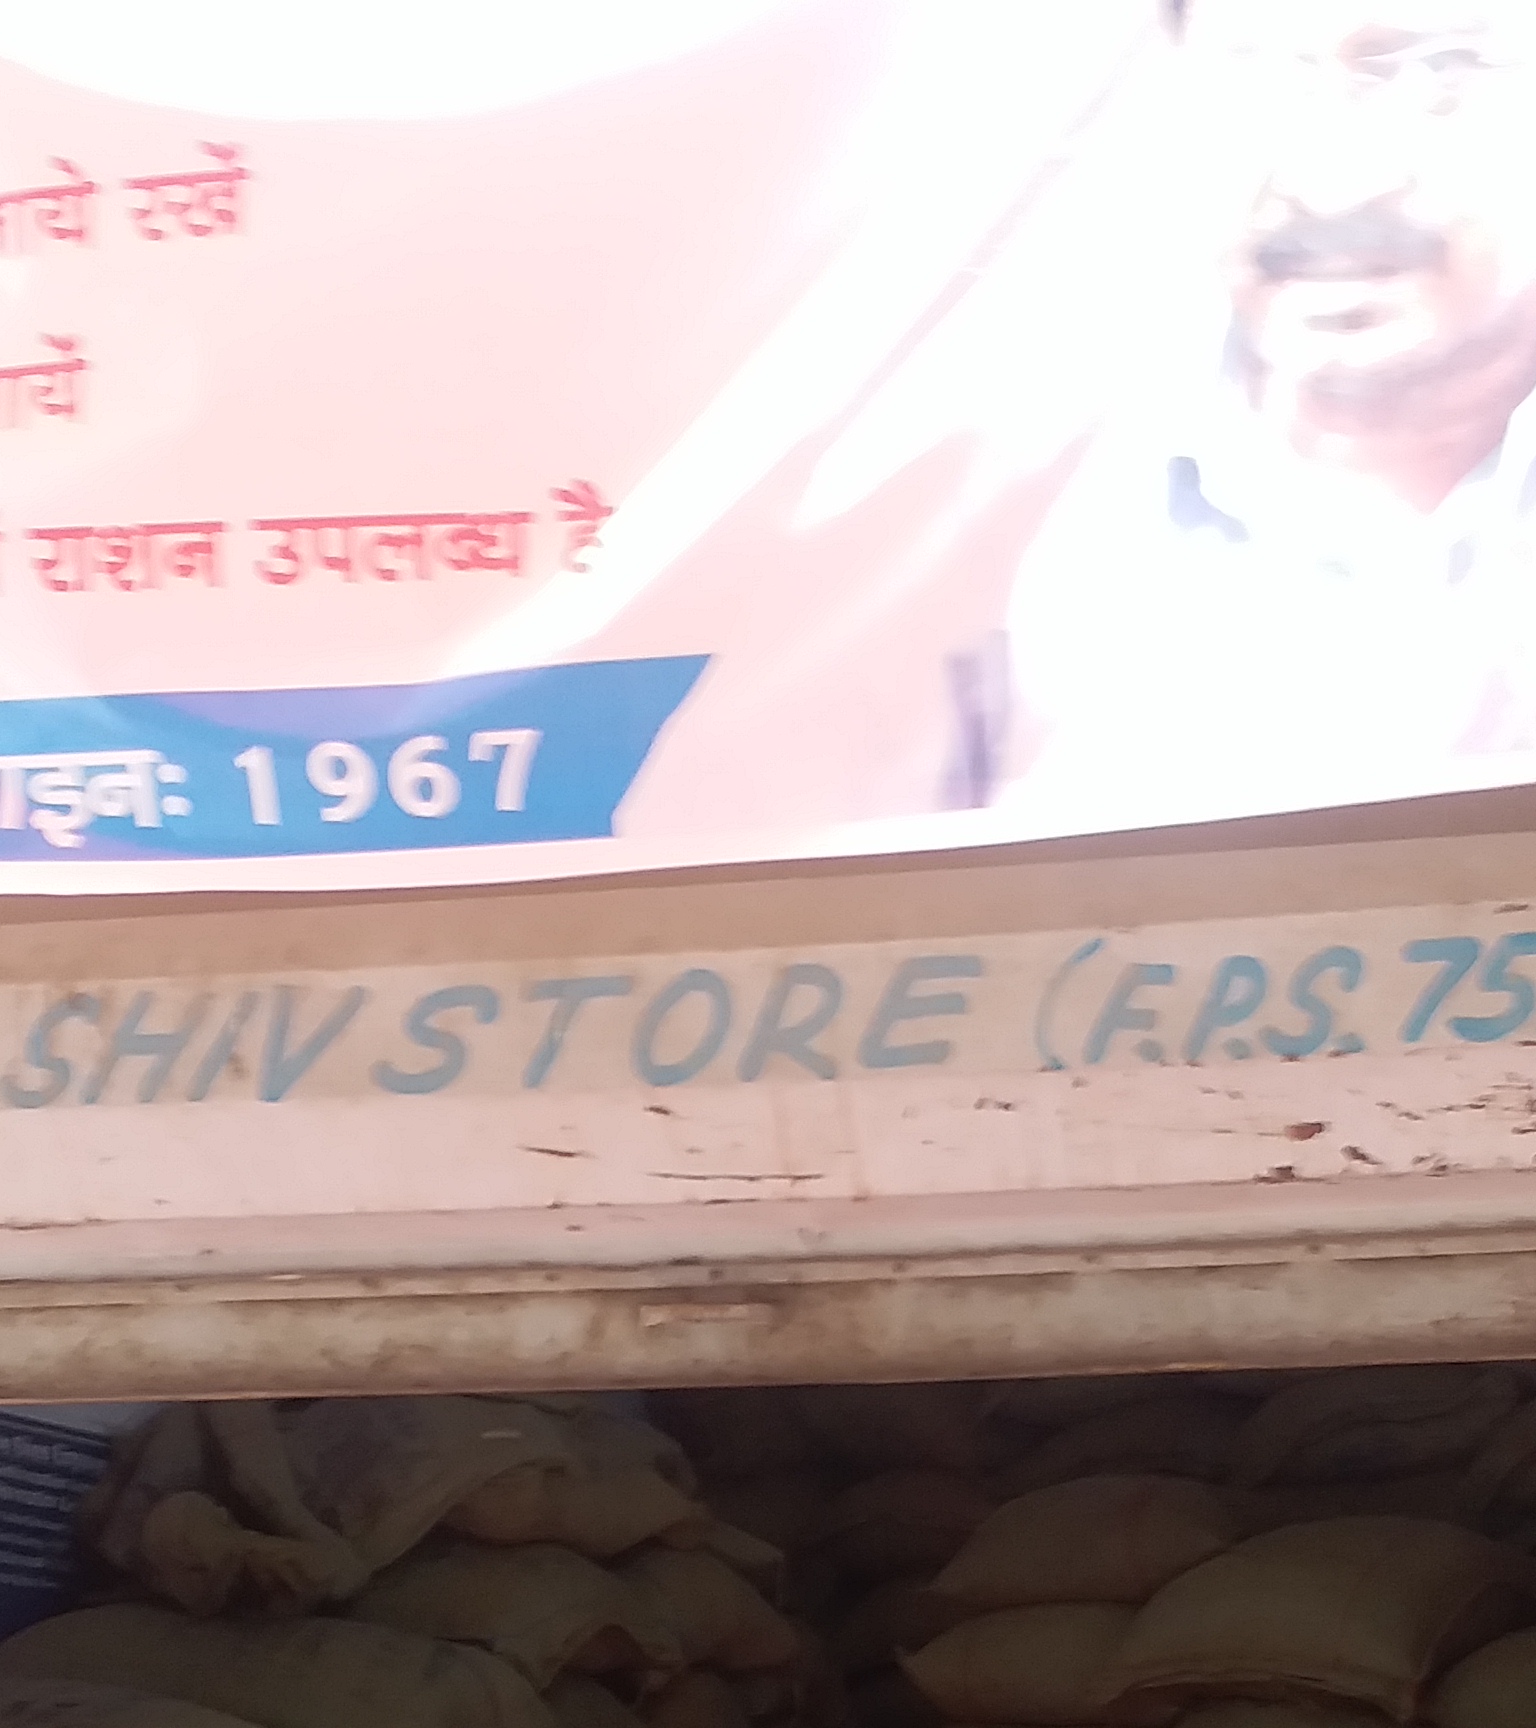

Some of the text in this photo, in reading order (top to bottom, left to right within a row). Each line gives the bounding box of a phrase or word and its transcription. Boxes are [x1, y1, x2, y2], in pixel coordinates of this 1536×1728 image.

[26, 521, 226, 593] राशन
[249, 511, 535, 587] उपलब्ध
[235, 726, 546, 828] 1967
[370, 952, 984, 1102] STORE
